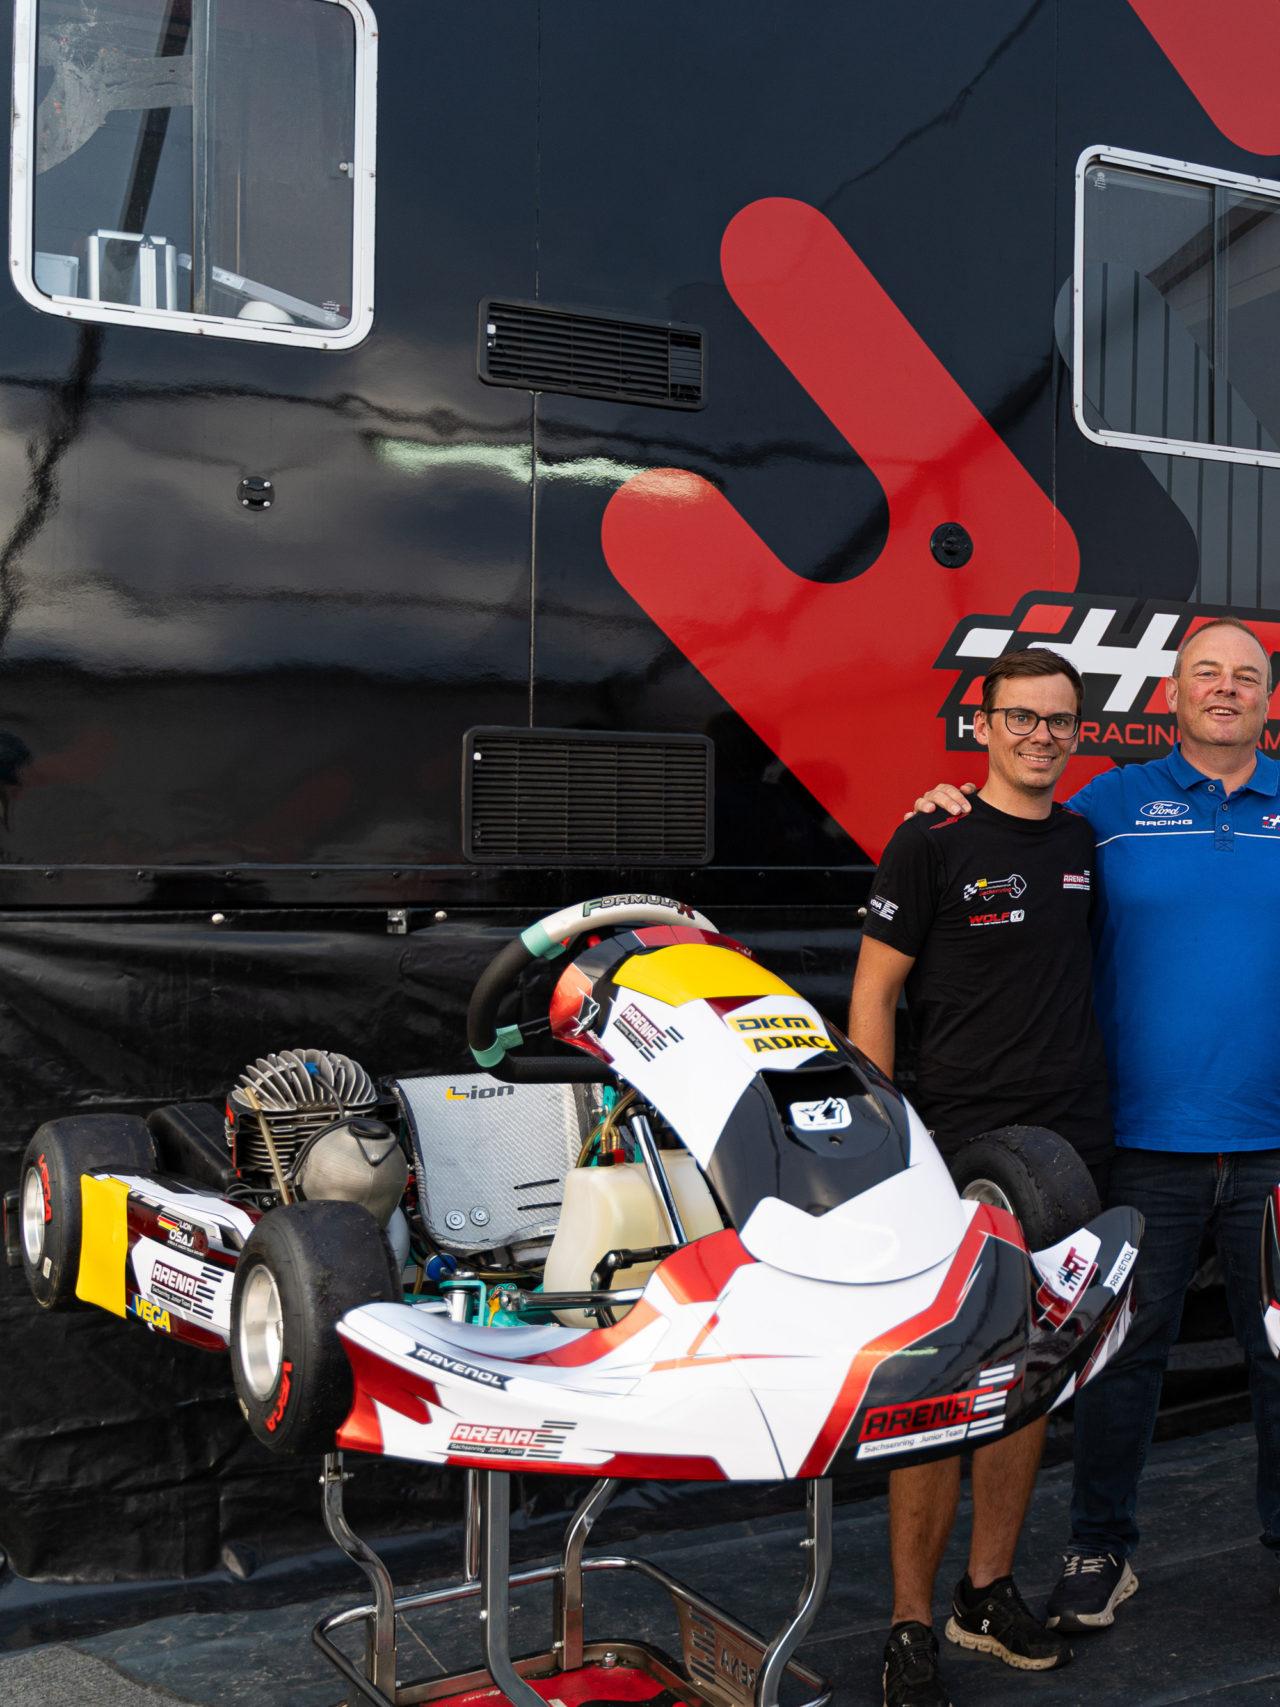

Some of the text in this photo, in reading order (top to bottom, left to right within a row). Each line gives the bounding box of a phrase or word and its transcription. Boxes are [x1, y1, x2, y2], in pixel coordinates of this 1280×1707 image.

[1079, 721, 1181, 746] RACIN
[1149, 803, 1180, 815] Ford
[968, 911, 1011, 924] WOLF
[620, 1005, 659, 1041] ARENA
[736, 1017, 811, 1031] DKM
[753, 1035, 831, 1053] ADAC
[446, 1084, 515, 1101] Lion
[168, 1228, 195, 1247] OSAJ
[152, 1263, 197, 1297] ARENA
[1109, 1249, 1135, 1288] RAVENOL
[134, 1294, 171, 1333] VEGA
[416, 1348, 502, 1386] RAVENOL
[865, 1396, 971, 1435] ARENA
[453, 1424, 533, 1445] ARENA
[863, 1427, 964, 1454] Sachsenring Junior Team
